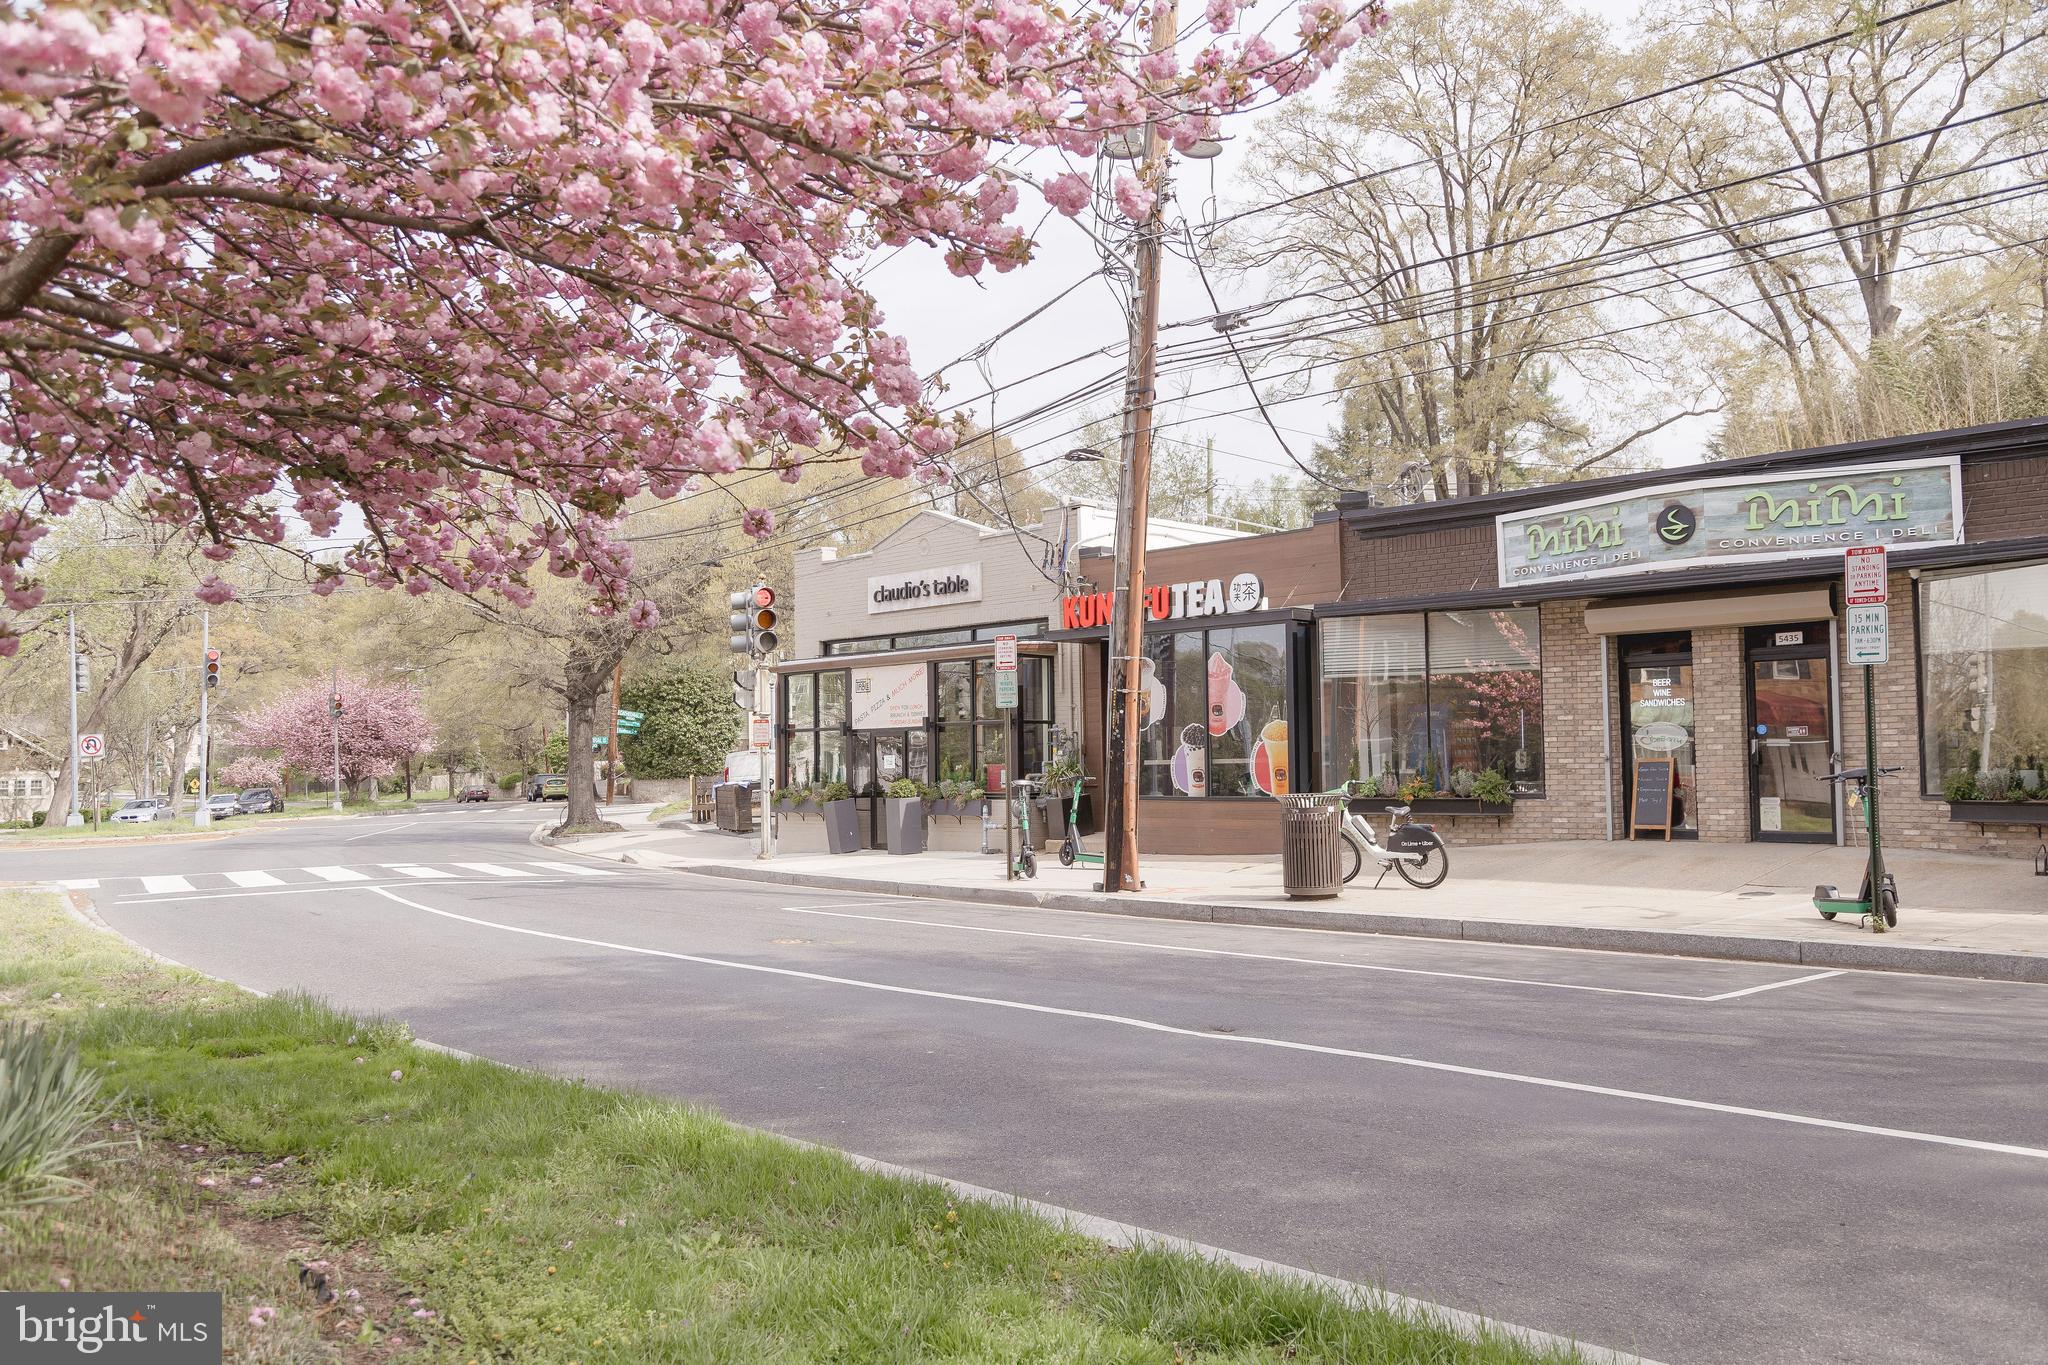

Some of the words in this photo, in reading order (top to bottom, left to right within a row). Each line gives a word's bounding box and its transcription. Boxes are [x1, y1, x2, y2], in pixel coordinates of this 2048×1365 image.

[1719, 530, 1864, 549] CONVENIENCE
[1892, 526, 1939, 537] DELI
[1512, 556, 1598, 576] CONVENIENCE
[1612, 550, 1642, 562] DELI
[1860, 556, 1871, 564] NO
[1851, 563, 1880, 572] STANDING
[1856, 571, 1882, 579] PARKING
[1854, 579, 1880, 587] ANYTIME
[873, 580, 931, 603] claudio's
[932, 574, 969, 596] table
[1241, 580, 1257, 602] 茶
[1062, 591, 1114, 630] KUN
[1172, 578, 1228, 619] TEA
[1854, 613, 1863, 623] 15
[1865, 612, 1880, 623] MIN
[1850, 624, 1884, 635] PARKING
[1778, 634, 1800, 643] 5435
[1652, 678, 1672, 687] BEER
[1652, 688, 1672, 697] WINE
[854, 711, 870, 726] PASTA
[870, 698, 886, 712] PIZZA
[891, 681, 908, 697] MUCH
[1640, 698, 1686, 707] SANDWICHES
